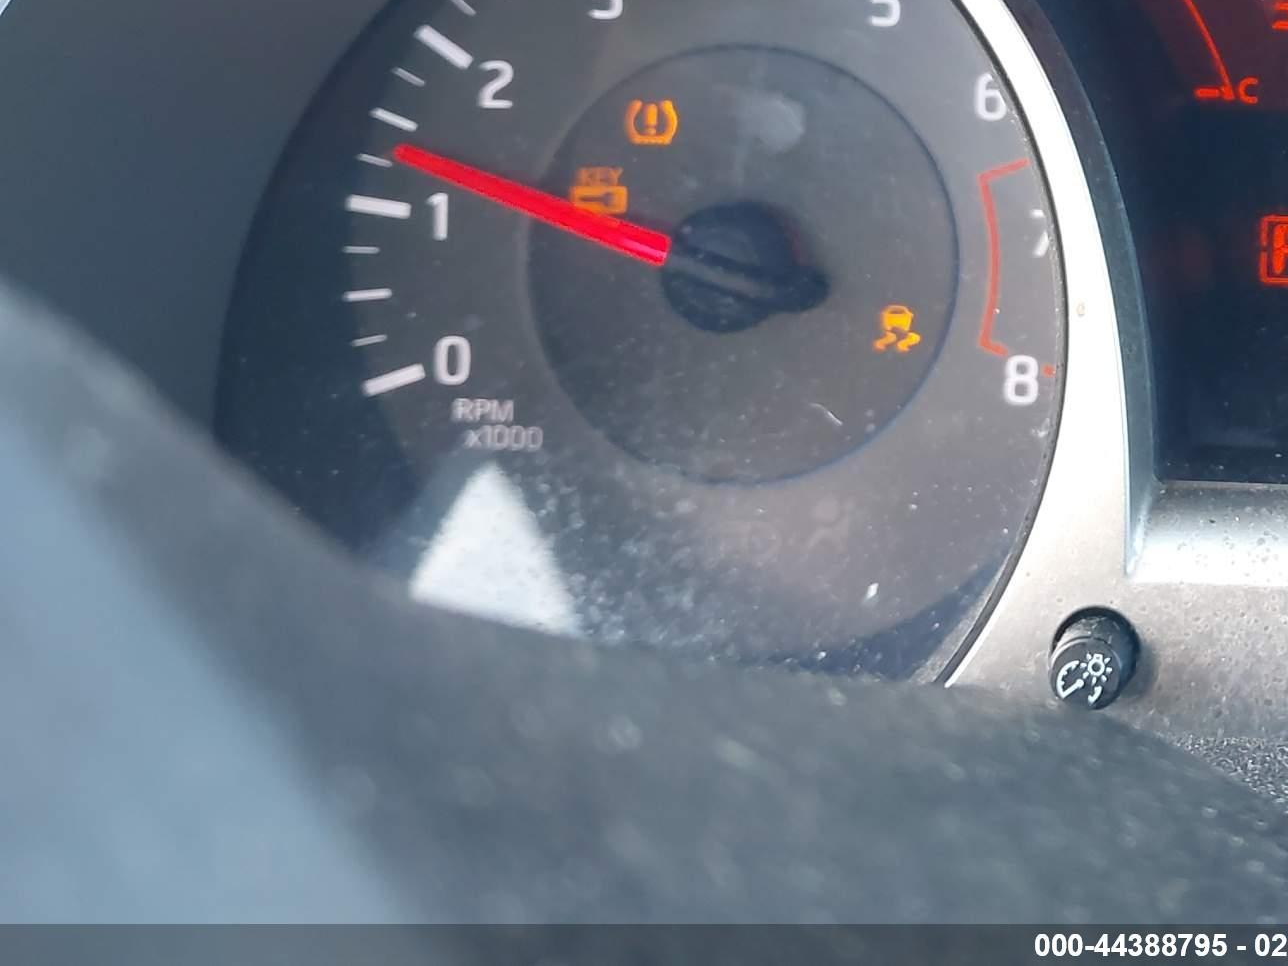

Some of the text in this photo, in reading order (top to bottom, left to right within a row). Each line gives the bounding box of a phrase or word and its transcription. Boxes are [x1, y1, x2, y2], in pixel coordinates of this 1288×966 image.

[479, 59, 513, 109] 2
[975, 73, 1007, 121] 6
[1239, 77, 1258, 104] C
[426, 193, 448, 239] 1
[435, 335, 471, 385] 0
[1004, 354, 1040, 406] 8
[452, 398, 514, 423] RPM
[464, 425, 543, 451] x1000
